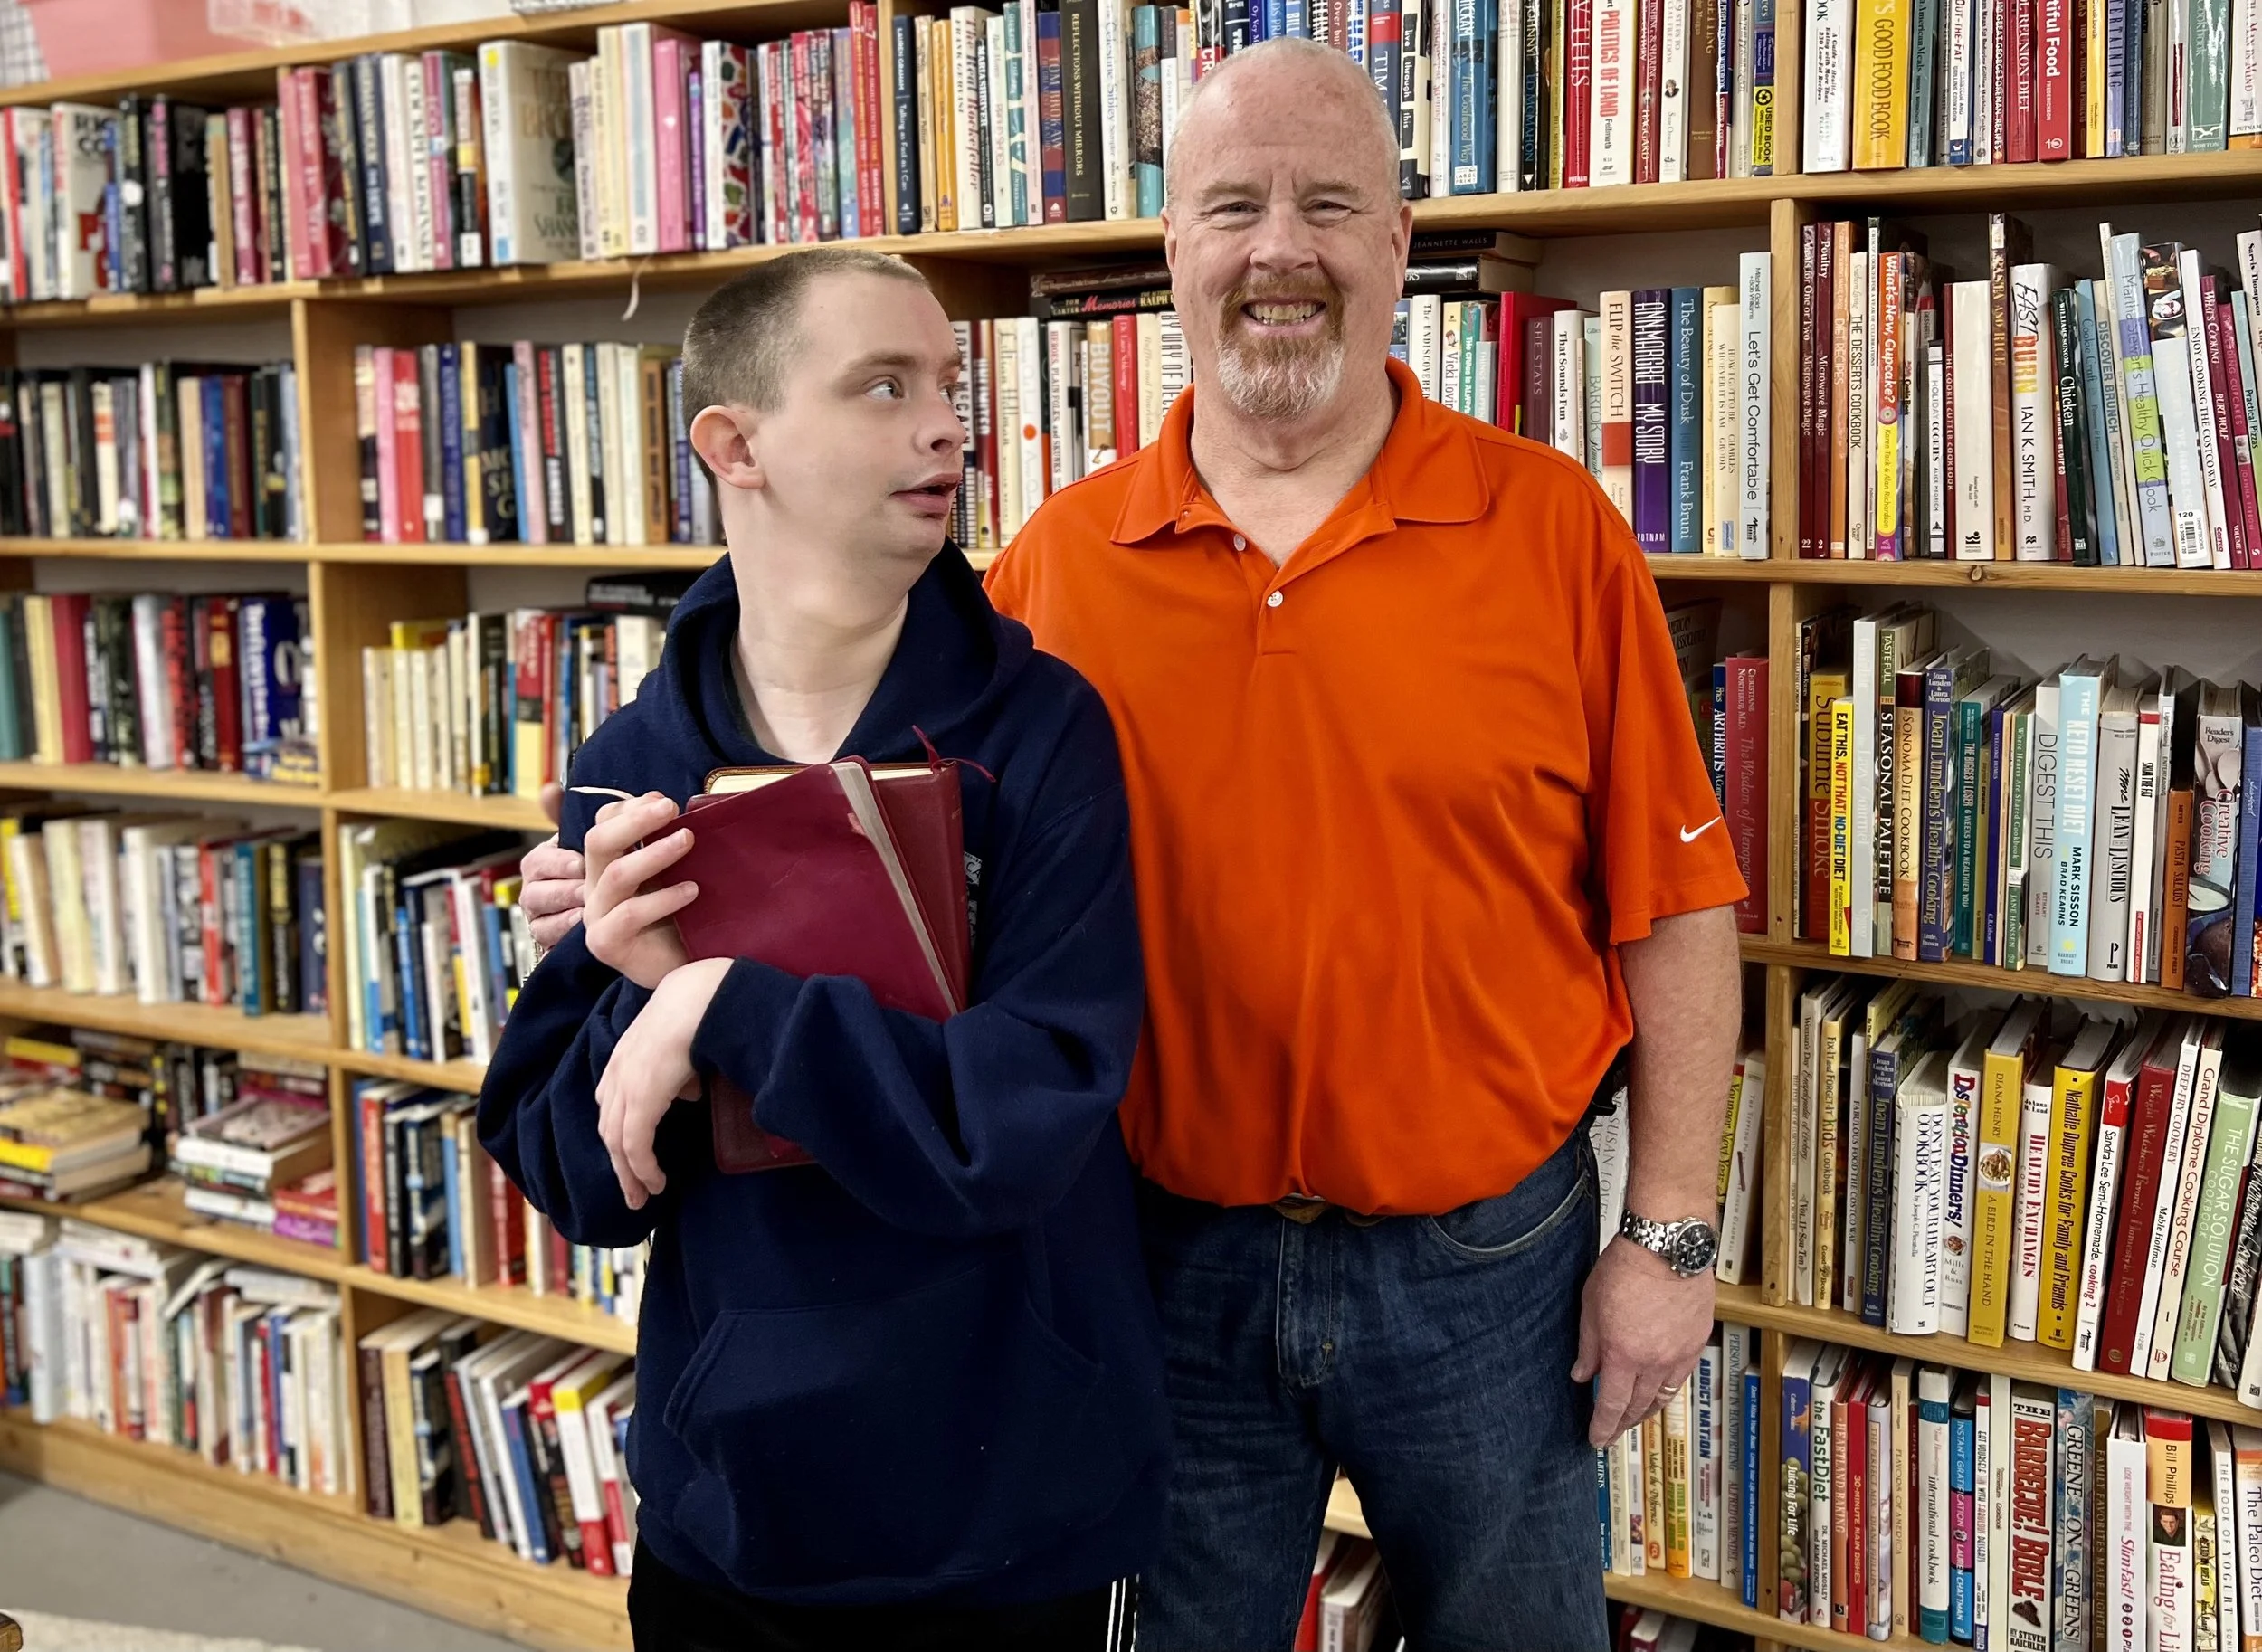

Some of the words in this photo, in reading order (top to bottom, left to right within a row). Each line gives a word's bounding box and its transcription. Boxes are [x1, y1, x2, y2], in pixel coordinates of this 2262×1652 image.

[897, 28, 905, 56] LAUREN
[1072, 14, 1081, 80] REFLECTIONS
[1404, 30, 1412, 46] live
[1601, 10, 1620, 63] POLITICS
[1873, 19, 1894, 58] GOOD
[1601, 68, 1619, 82] OF
[2045, 38, 2060, 76] Food
[1402, 62, 1411, 98] through
[1871, 62, 1893, 99] FOOD
[1073, 82, 1082, 128] WITHOUT
[1403, 113, 1411, 128] this
[1600, 87, 1618, 118] LAND
[1764, 107, 1773, 133] USED
[1870, 102, 1891, 140] BOOK
[1075, 131, 1083, 176] MIRRORS
[1763, 136, 1773, 162] BOOK
[1413, 240, 1457, 249] JEANNETTE
[1462, 237, 1487, 245] WALLS
[1886, 255, 1898, 299] What's
[1680, 299, 1694, 325] The
[2015, 283, 2039, 341] FAST
[2122, 274, 2138, 319] Martha
[2204, 290, 2218, 320] WHAT'S
[1534, 322, 1542, 347] SHE
[1609, 303, 1623, 331] FLIP
[1851, 315, 1862, 334] THE
[1884, 305, 1894, 336] New,
[2059, 302, 2069, 368] WILLIAMS-SONOMA
[1558, 331, 1568, 356] That
[1611, 335, 1621, 350] the
[1635, 303, 1665, 385] ANN-MARGRET
[1677, 328, 1693, 369] Beauty
[1748, 331, 1761, 368] Let's
[2098, 321, 2114, 381] DISCOVER
[2127, 325, 2144, 379] Stewart's
[2191, 327, 2203, 355] ENJOY
[2207, 323, 2219, 364] COOKING
[1050, 367, 1060, 393] PLAIN
[1534, 356, 1542, 395] STAYS
[1558, 359, 1568, 397] Sounds
[1680, 374, 1694, 388] of
[1850, 339, 1862, 391] DESSERTS
[1882, 338, 1896, 402] Cupcake?
[2013, 336, 2038, 394] BURN
[2193, 358, 2209, 404] COOKING
[1090, 343, 1111, 432] BUYOUT
[1611, 355, 1623, 417] SWITCH
[1748, 373, 1760, 401] Get
[2060, 375, 2076, 426] Chicken
[2215, 393, 2225, 415] BURT
[1559, 400, 1568, 420] Fun
[1635, 403, 1665, 422] MY
[1680, 392, 1693, 424] Dusk
[1851, 394, 1861, 448] COOKBOOK
[2021, 406, 2034, 432] IAN
[2105, 385, 2117, 433] BRUNCH
[2130, 384, 2151, 431] Healthy
[2200, 407, 2212, 426] THE
[1635, 426, 1665, 463] STORY
[2022, 439, 2034, 451] K.
[2219, 417, 2228, 441] WOLF
[1052, 441, 1061, 473] SKUNKS
[1748, 405, 1760, 500] Comfortable
[2140, 434, 2160, 473] Quick
[2202, 429, 2216, 468] COSTCO
[1679, 461, 1693, 499] Frank
[2022, 454, 2035, 501] SMITH,
[2145, 477, 2162, 513] Cook
[1680, 502, 1693, 538] Bruni
[2081, 690, 2091, 715] THE
[1714, 709, 1726, 771] ARTHRITIS
[1836, 713, 1848, 733] EAT
[2066, 720, 2089, 754] KETO
[1834, 735, 1847, 759] THIS,
[1881, 713, 1893, 808] SEASONAL
[1902, 717, 1914, 772] SONOMA
[1964, 744, 1974, 755] THE
[1835, 762, 1847, 783] NOT
[1963, 757, 1974, 783] BIGGEST
[2037, 735, 2058, 809] DIGEST
[2064, 759, 2087, 802] RESET
[1835, 784, 1848, 813] THAT!
[1902, 775, 1912, 803] DIET
[1963, 786, 1974, 806] LOSER
[1834, 816, 1846, 858] NO-DIET
[2034, 815, 2055, 859] THIS
[2063, 805, 2086, 836] DIET
[2194, 801, 2216, 875] Cooking
[2217, 789, 2234, 858] Creative
[1879, 818, 1891, 894] PALETTE
[1899, 808, 1912, 878] COOKBOOK
[1834, 859, 1846, 881] DIET
[2059, 861, 2067, 887] BRAD
[2071, 847, 2082, 880] MARK
[2058, 889, 2067, 926] KEARNS
[2069, 884, 2080, 926] SISSON
[1994, 1073, 2004, 1104] DIANA
[2199, 1068, 2215, 1109] Grand
[1992, 1107, 2002, 1137] HENRY
[2064, 1089, 2083, 1129] Nathalie
[1931, 1114, 1943, 1155] DON'T
[2060, 1132, 2079, 1166] Dupree
[2189, 1112, 2209, 1168] Diplôme
[2224, 1128, 2243, 1154] THE
[1915, 1114, 1930, 1193] COOKBOOK
[1929, 1159, 1941, 1188] EAT
[1944, 1153, 1968, 1228] Dinners!
[2058, 1170, 2077, 1199] Cooks
[2215, 1157, 2238, 1210] SUGAR
[1927, 1190, 1940, 1226] YOUR
[2058, 1201, 2076, 1216] for
[2175, 1172, 2197, 1227] Cooking
[1986, 1207, 1996, 1231] BIRD
[2053, 1218, 2074, 1251] Family
[1925, 1230, 1937, 1277] HEART
[1986, 1235, 1995, 1246] IN
[2170, 1231, 2188, 1277] Course
[2201, 1213, 2229, 1287] SOLUTION
[1984, 1249, 1994, 1270] THE
[2054, 1253, 2071, 1271] and
[1923, 1279, 1935, 1307] OUT
[1982, 1273, 1992, 1306] HAND
[2051, 1273, 2069, 1310] Friends
[1814, 1400, 1825, 1420] the
[1956, 1421, 1964, 1458] INSTANT
[2165, 1444, 2178, 1462] Bill
[1814, 1426, 1830, 1502] FastDiet
[2012, 1418, 2052, 1536] BARBECUE!
[2067, 1426, 2084, 1497] GREENE
[1785, 1466, 1798, 1498] Juicing
[1956, 1461, 1964, 1527] GRATIFICATION
[2163, 1466, 2177, 1504] Phillips
[1787, 1502, 1797, 1516] For
[2247, 1486, 2262, 1517] The
[1787, 1518, 1798, 1535] Life
[2067, 1518, 2082, 1544] ON
[2248, 1524, 2262, 1563] Paleo
[1956, 1544, 1964, 1575] LAUREN
[2012, 1535, 2049, 1601] BIBLE
[2154, 1549, 2184, 1610] Eating
[2250, 1567, 2262, 1600] Diet
[1956, 1577, 1964, 1620] CHATTMAN
[2064, 1569, 2081, 1638] GREENS
